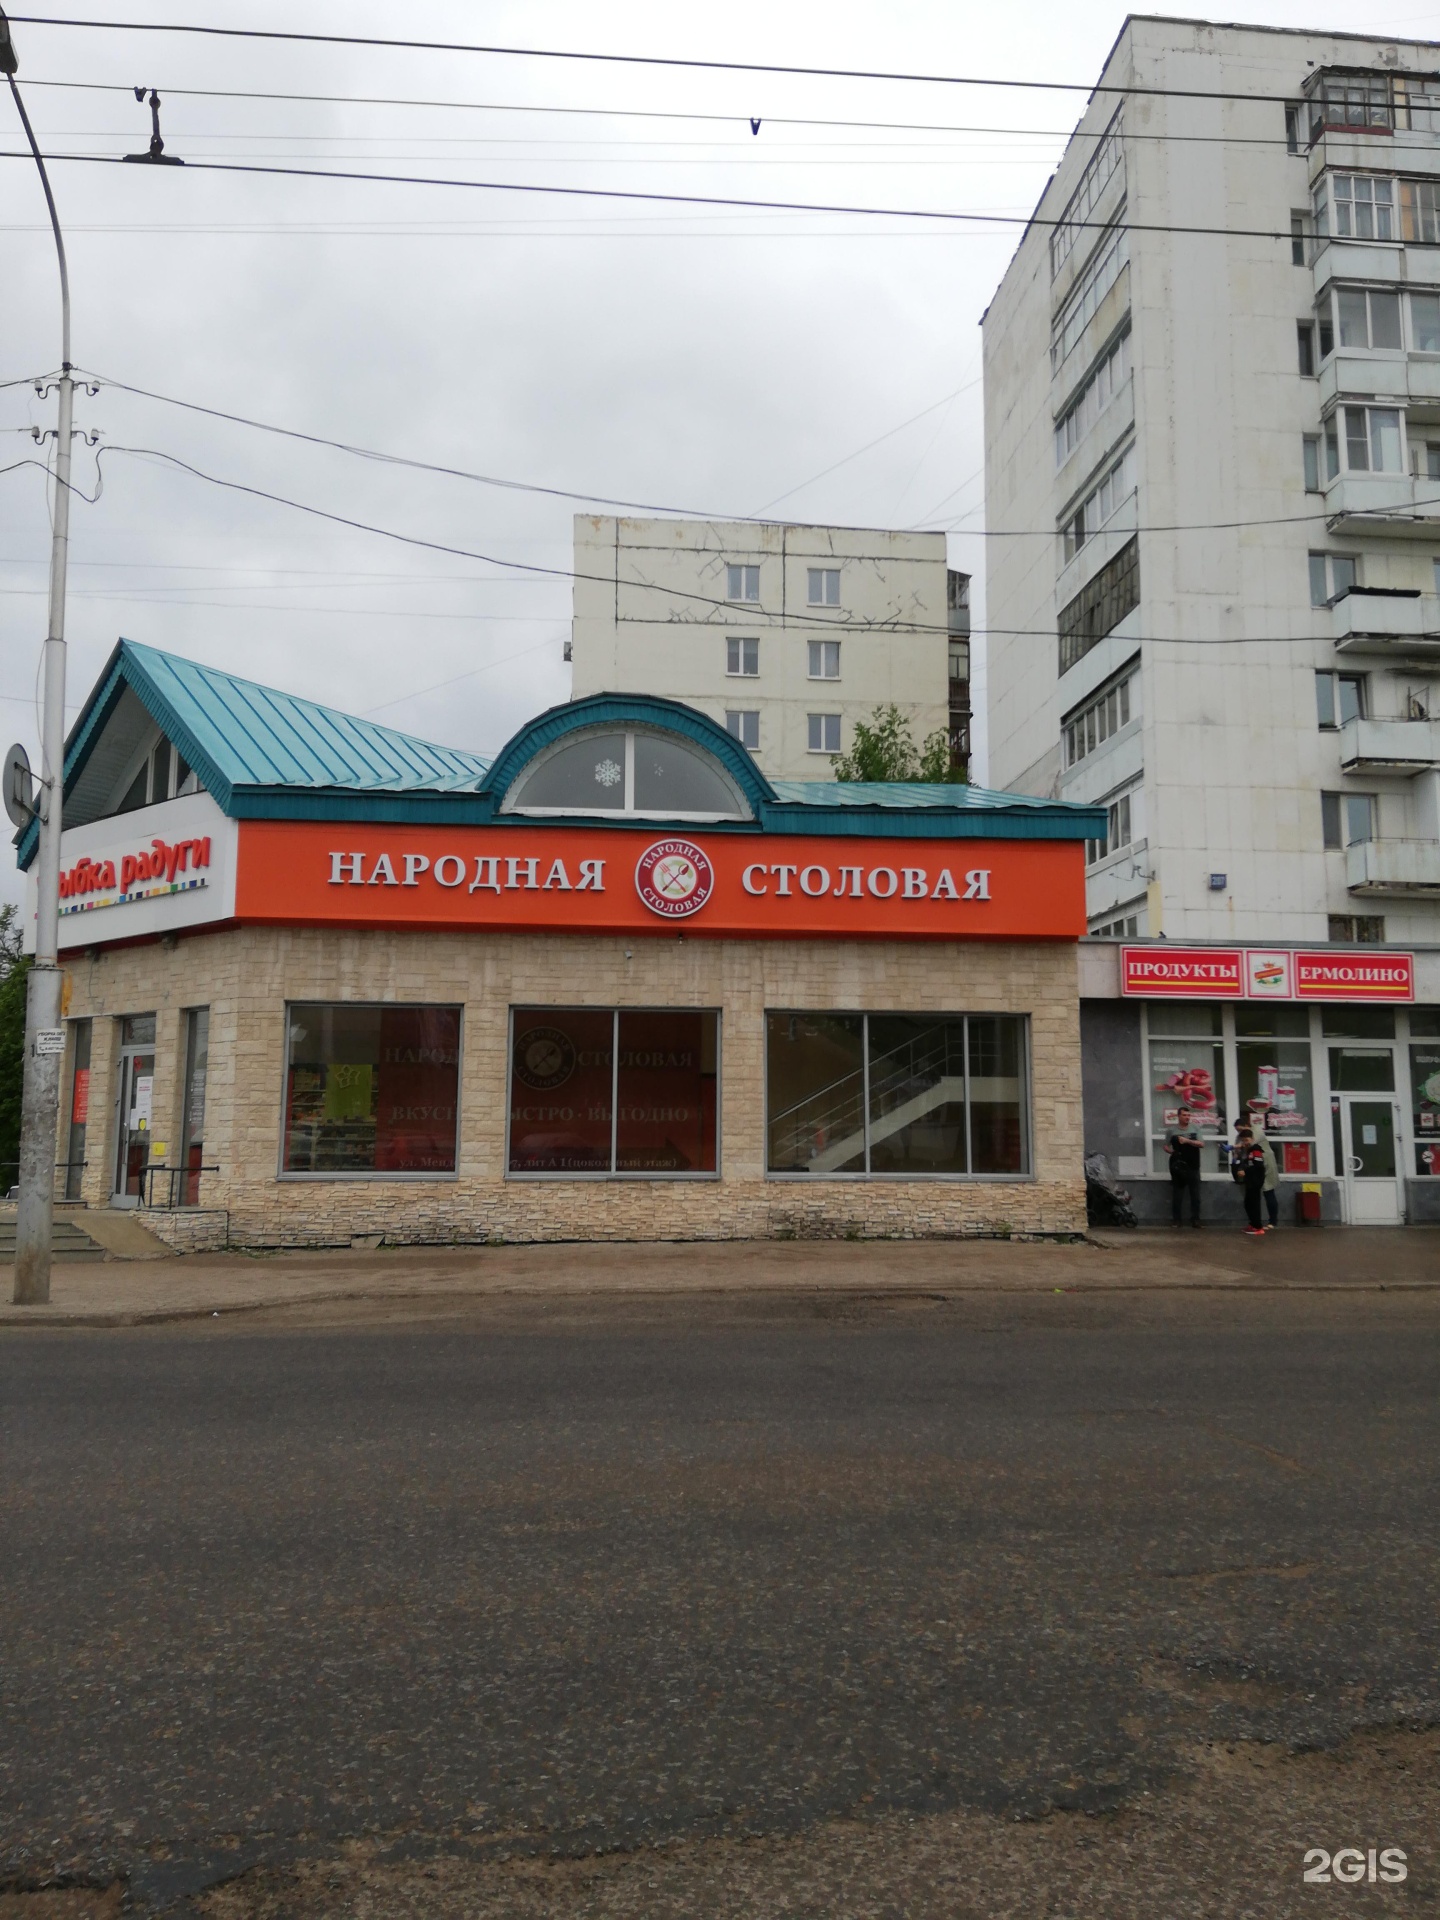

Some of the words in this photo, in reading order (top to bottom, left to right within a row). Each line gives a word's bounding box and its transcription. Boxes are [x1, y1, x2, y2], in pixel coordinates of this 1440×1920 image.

[59, 858, 116, 899] ыбка
[121, 836, 212, 894] радуги
[642, 843, 707, 871] НАРОДНАЯ
[328, 852, 606, 894] НАРОДНАЯ
[741, 864, 993, 901] СТОЛОВАЯ
[643, 887, 707, 913] СТОЛОВАЯ
[1128, 962, 1238, 979] ПРОДУКТЫ
[1300, 966, 1408, 982] ЕРМОЛИНО
[384, 1047, 458, 1066] НАРОД
[392, 1106, 456, 1121] ВКУСН
[511, 1107, 574, 1121] ЫСТРО
